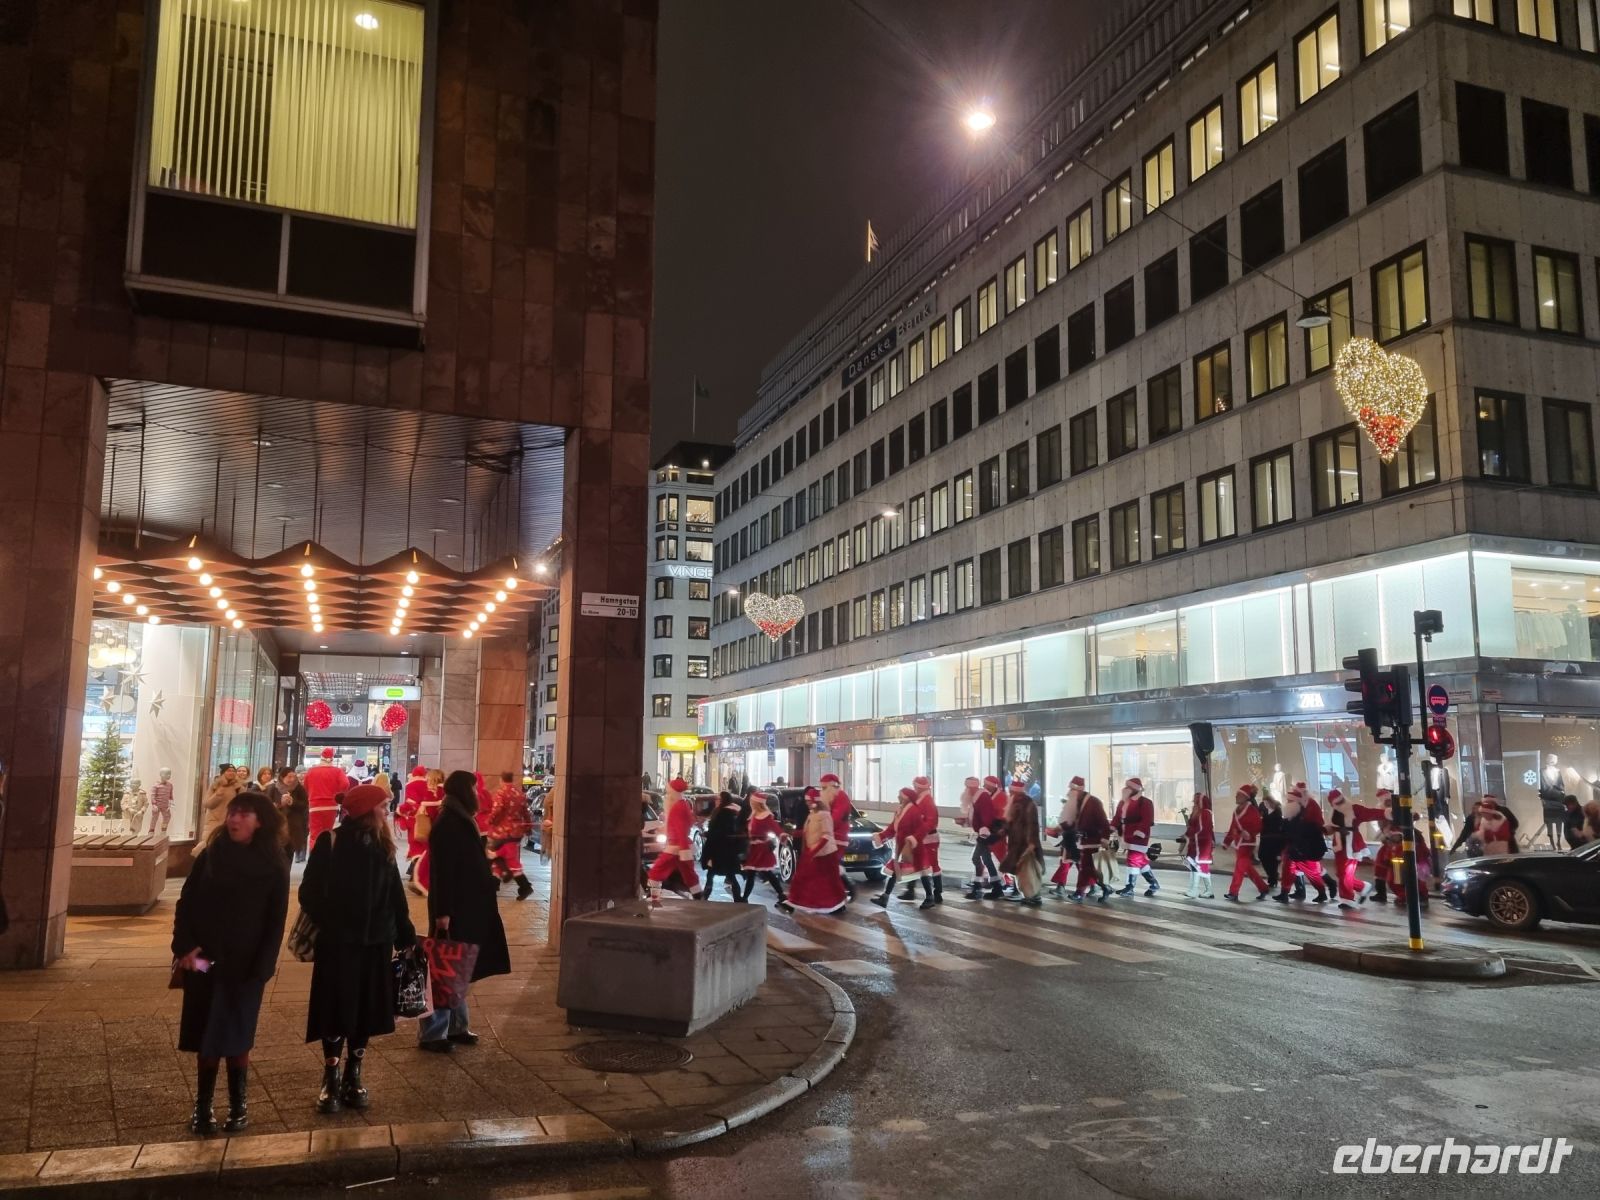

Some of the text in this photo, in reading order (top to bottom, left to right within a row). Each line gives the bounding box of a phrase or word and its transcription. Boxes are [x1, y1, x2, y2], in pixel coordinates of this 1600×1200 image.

[848, 303, 931, 378] Danske Bank
[600, 596, 637, 605] Hamngatan
[617, 608, 637, 616] 20-10
